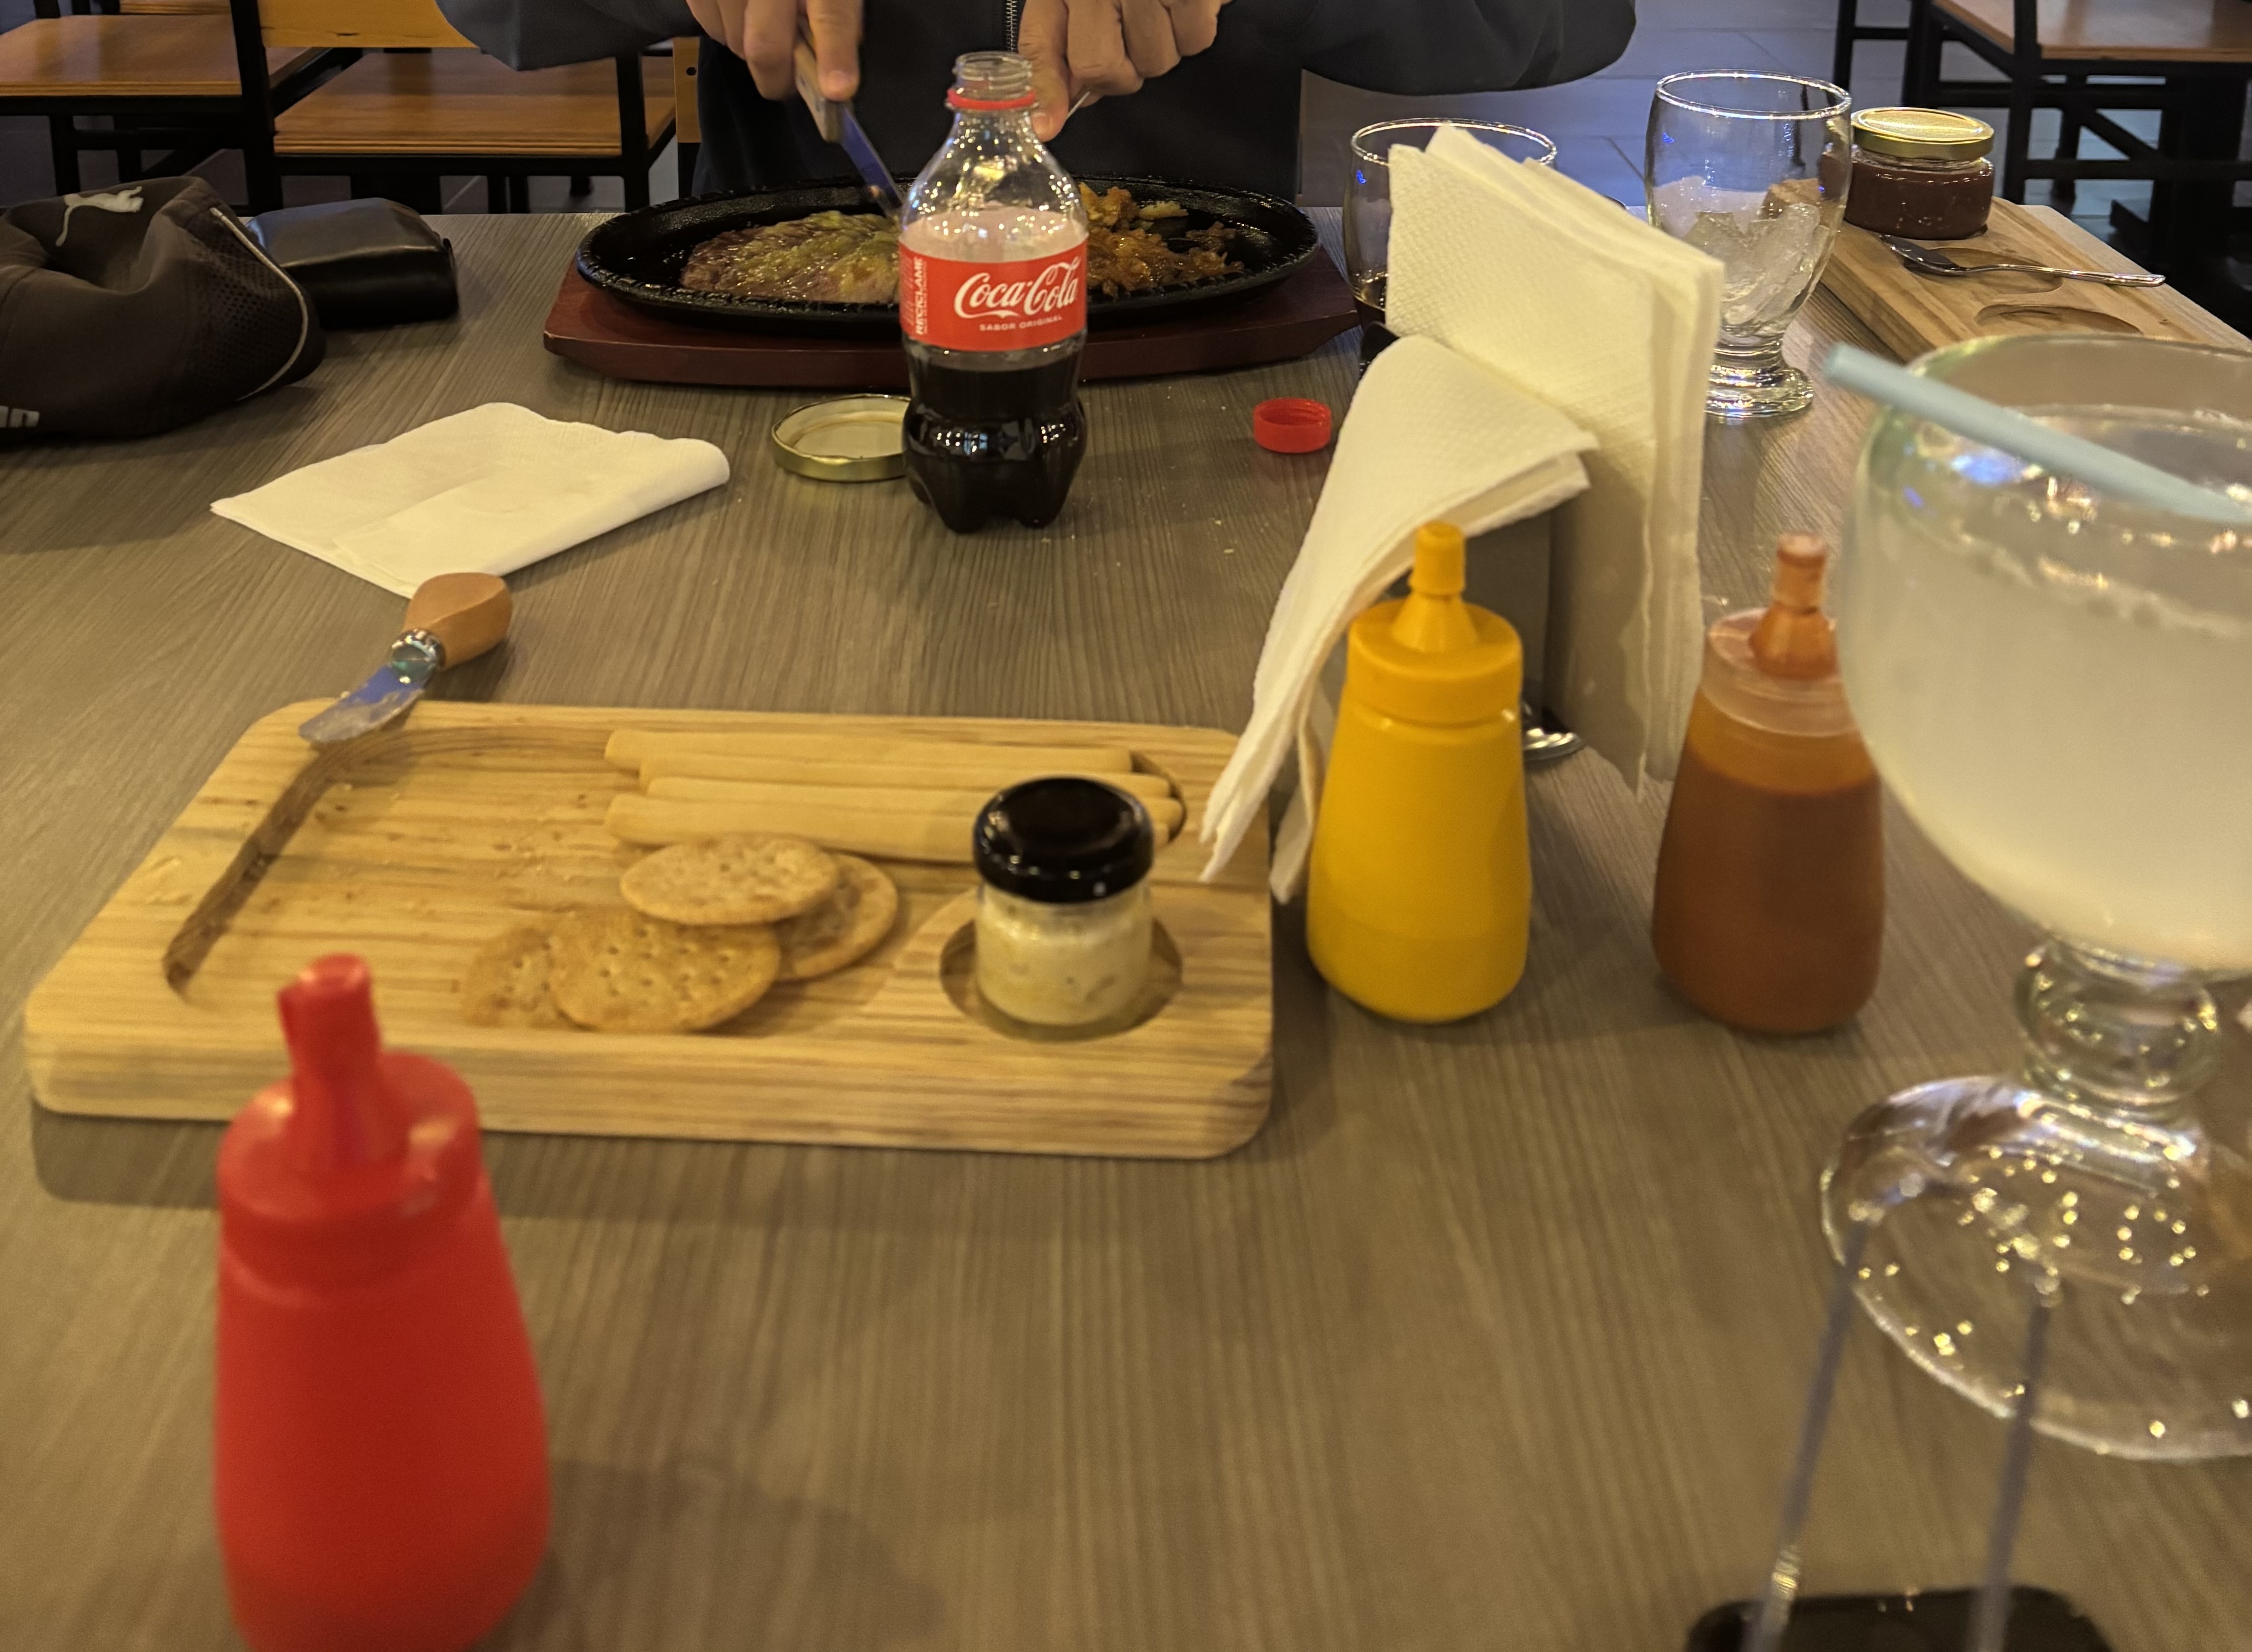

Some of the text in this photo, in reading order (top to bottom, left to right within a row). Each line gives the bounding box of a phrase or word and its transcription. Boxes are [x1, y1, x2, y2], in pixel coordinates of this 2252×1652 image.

[954, 256, 1081, 319] Coca-Cola
[979, 315, 1063, 332] SABOR ORIGINAL
